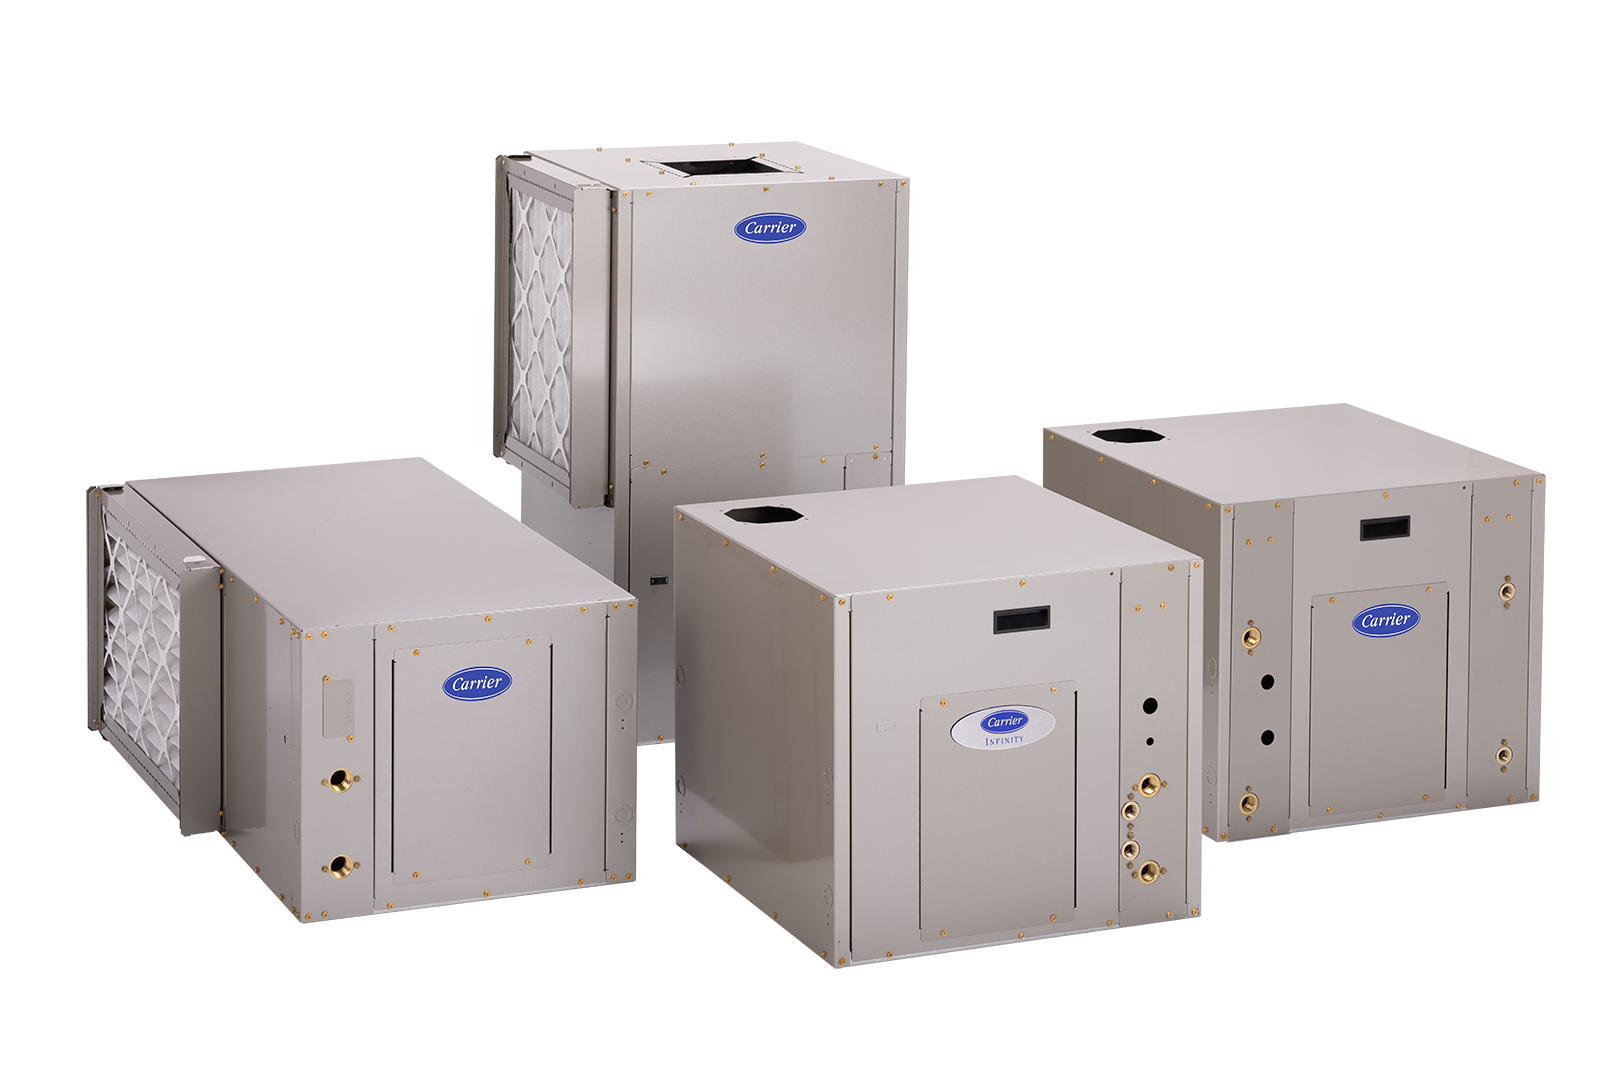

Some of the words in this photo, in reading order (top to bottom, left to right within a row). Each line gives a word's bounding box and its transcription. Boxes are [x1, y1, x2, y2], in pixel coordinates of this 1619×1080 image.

[745, 220, 797, 235] Carrier
[1361, 612, 1411, 629] Carrier
[452, 675, 503, 692] Carrier
[987, 715, 1023, 728] Carrier
[985, 735, 1024, 747] INFINITY
